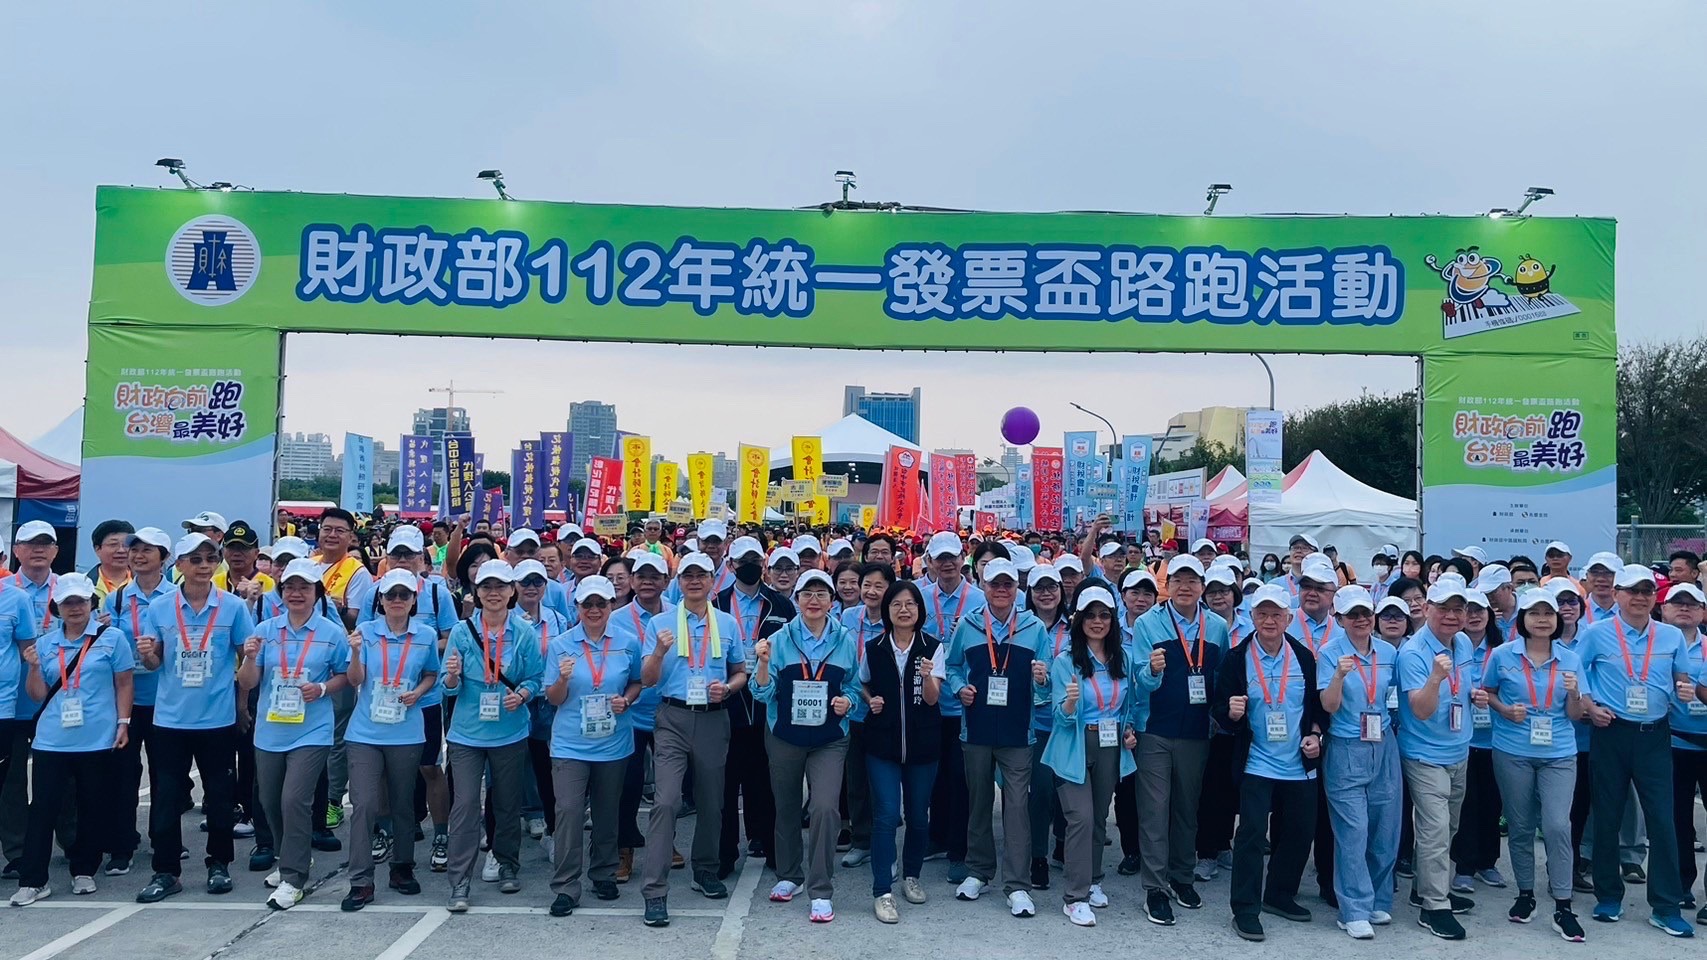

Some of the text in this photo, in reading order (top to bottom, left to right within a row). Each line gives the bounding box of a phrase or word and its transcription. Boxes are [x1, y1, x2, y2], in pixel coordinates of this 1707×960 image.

[301, 228, 1399, 319] 財政部112年統一發票盃路跑活動
[121, 368, 241, 376] 財政部112年統一發票盃路跑活動
[117, 381, 241, 410] 財政向前跑
[1458, 396, 1580, 406] 財政部112年統一發票盃路跑活動
[127, 411, 244, 439] 台灣最美好
[1455, 411, 1581, 439] 財政向前跑
[1466, 441, 1585, 468] 台灣最美好
[1077, 461, 1085, 496] 財稅會計
[1130, 467, 1141, 501] 財稅會計
[797, 698, 822, 706] 06001
